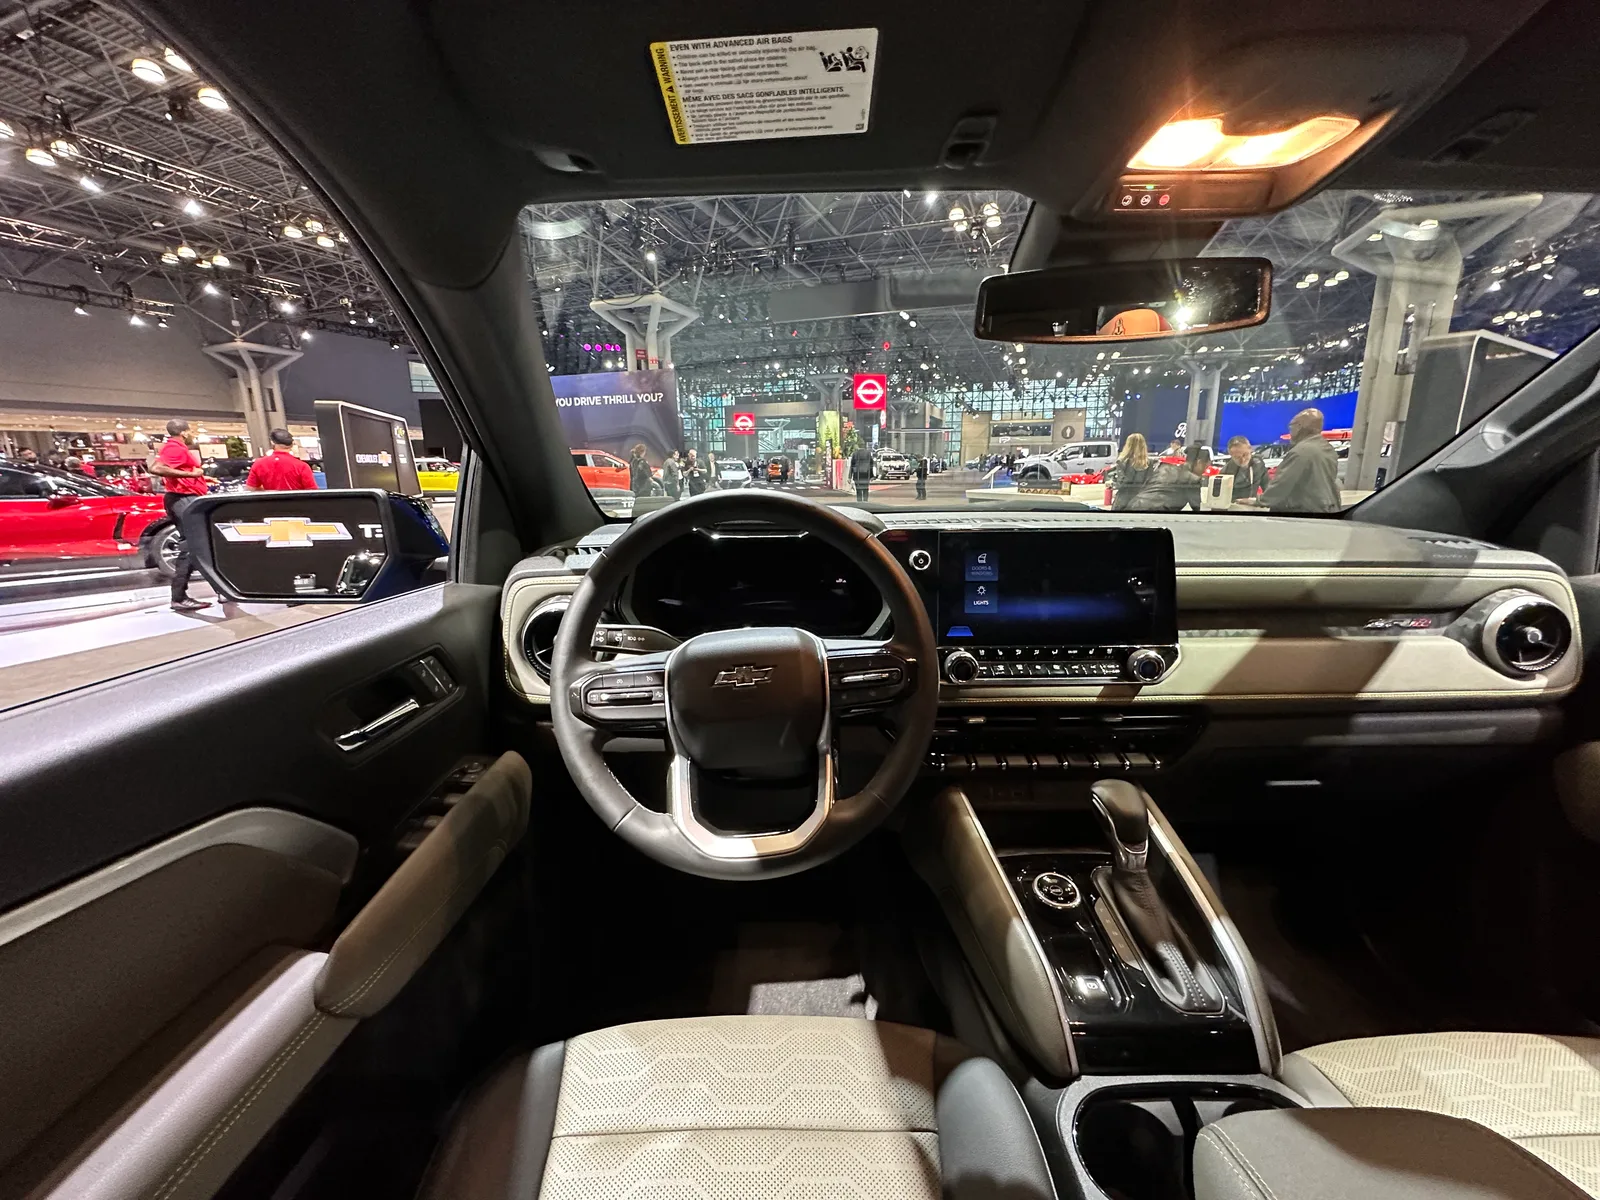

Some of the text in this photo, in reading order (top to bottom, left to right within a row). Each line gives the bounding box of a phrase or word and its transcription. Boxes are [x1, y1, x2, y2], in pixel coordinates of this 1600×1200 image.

[669, 36, 793, 51] EVEN WITH ADVANCED AIR BAGS
[655, 48, 673, 83] WARNING
[756, 89, 797, 98] GONFLABLES
[799, 86, 844, 95] INTELLIGENTS
[667, 95, 687, 141] AVERTISSEMENT
[574, 396, 601, 406] DRIVE
[603, 393, 636, 404] THRILL
[637, 392, 664, 402] YOU?
